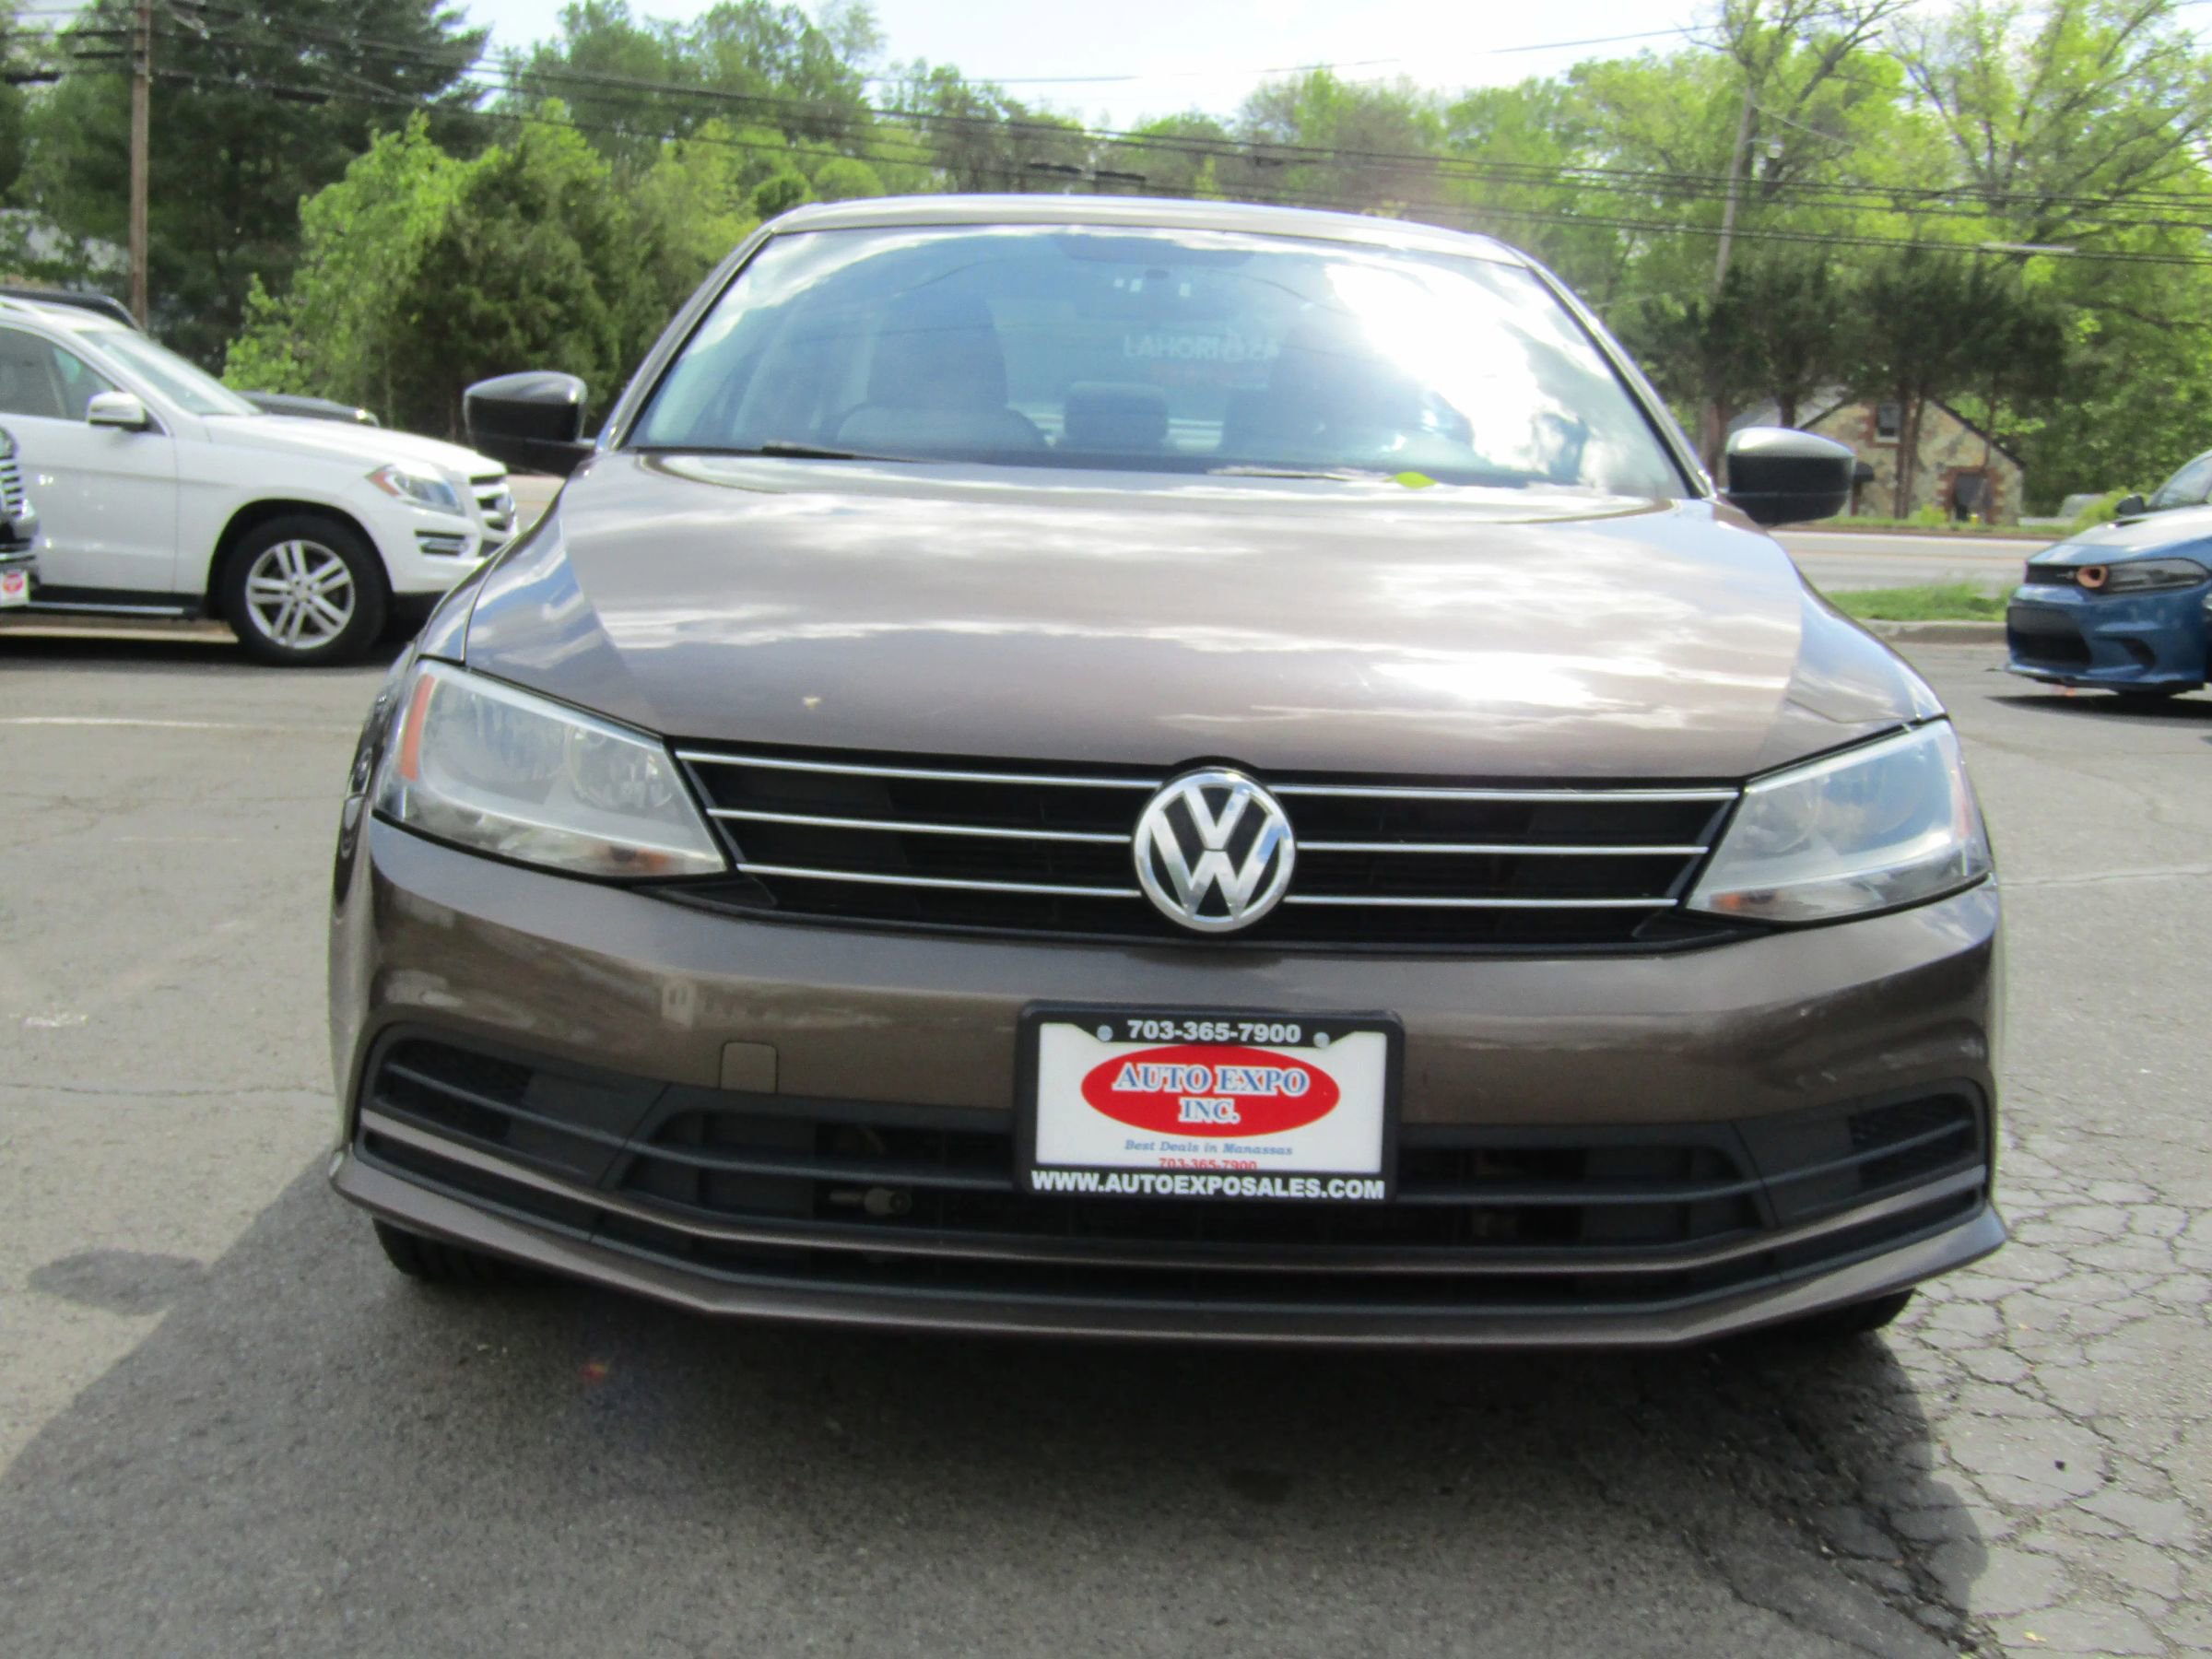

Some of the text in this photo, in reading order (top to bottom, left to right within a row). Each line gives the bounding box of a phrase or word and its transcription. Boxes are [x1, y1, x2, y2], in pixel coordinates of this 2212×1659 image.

[1126, 1019, 1301, 1043] 703-365-7900
[1112, 1063, 1310, 1097] AUTO EXPO
[1179, 1098, 1240, 1123] INC.
[1124, 1139, 1293, 1157] Best Deals in Manassas
[1159, 1158, 1257, 1171] 703-365-7900
[1030, 1171, 1385, 1200] WWW.AUTOEXPOSALES.COM
